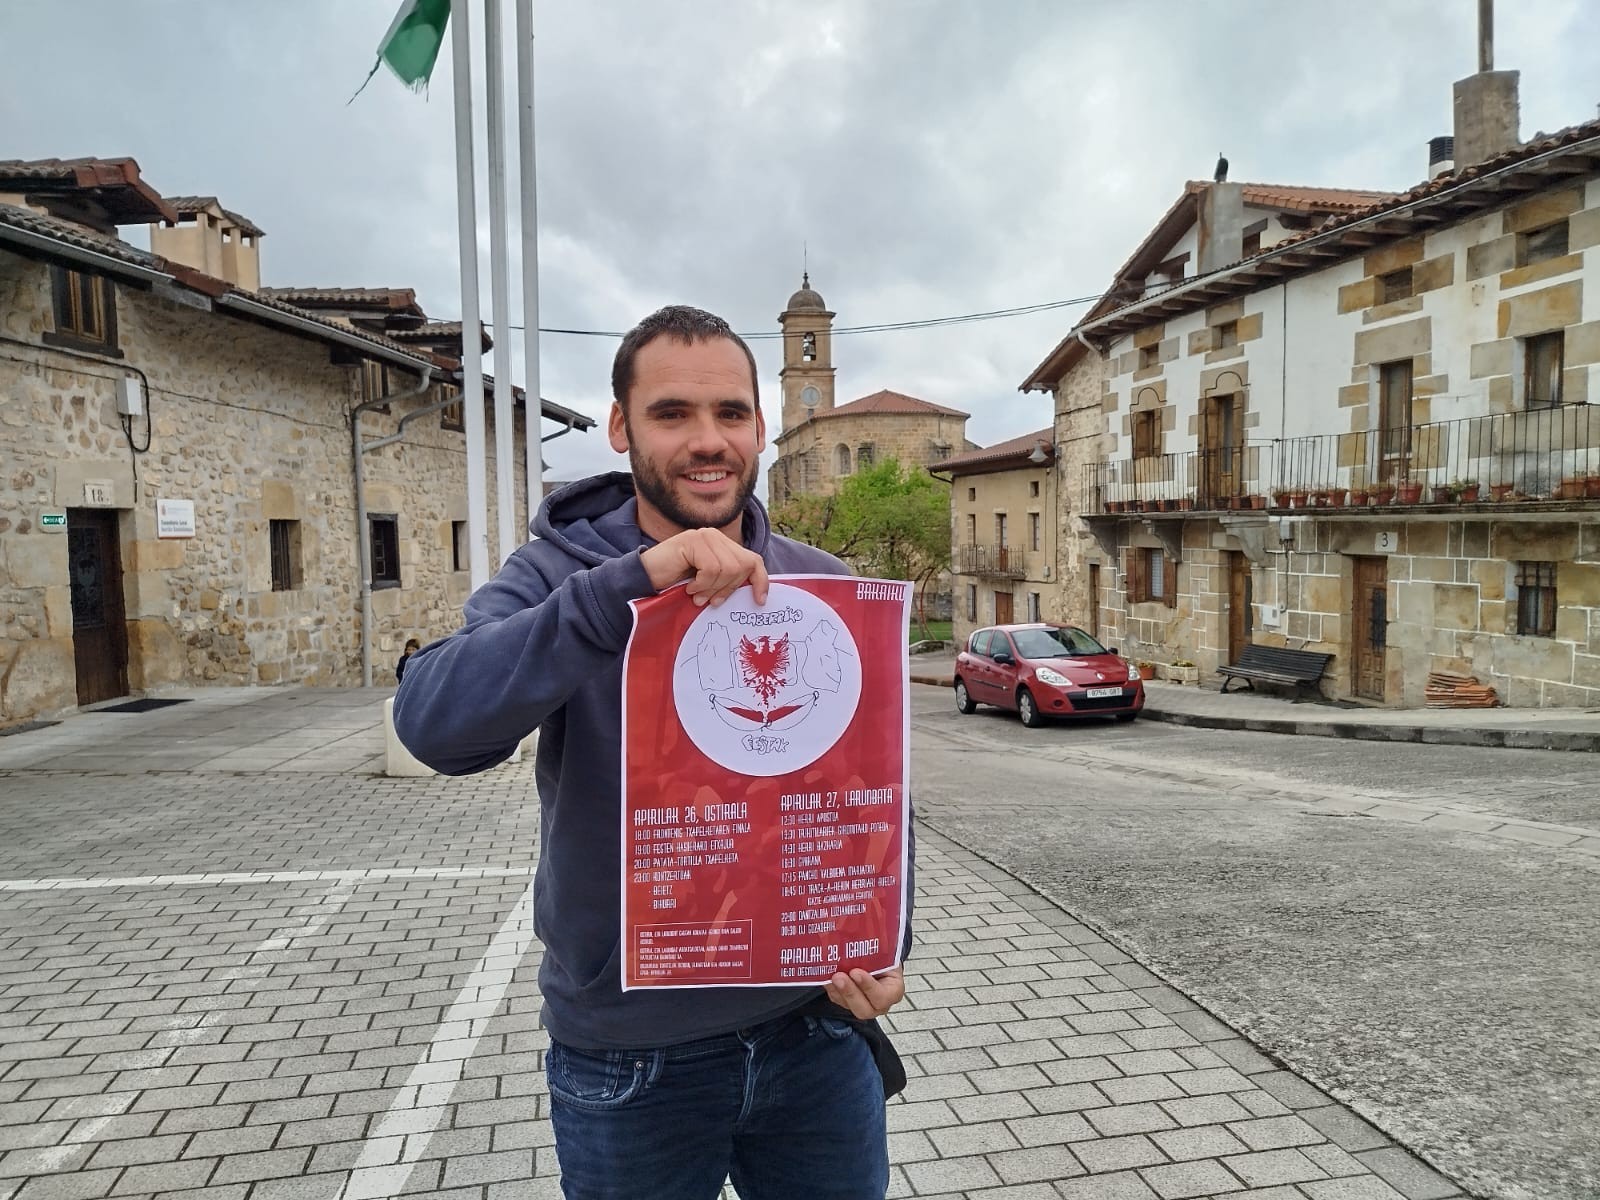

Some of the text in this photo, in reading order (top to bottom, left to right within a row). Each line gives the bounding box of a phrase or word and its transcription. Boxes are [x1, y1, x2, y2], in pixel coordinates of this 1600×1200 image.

[1382, 532, 1388, 548] 3
[856, 582, 905, 601] BAKAIKU
[741, 734, 790, 755] FESTAK
[780, 788, 892, 812] APIRILAK 27, LARUNBATA
[634, 802, 747, 826] APIRILAK 26, OSTIRALA
[653, 842, 674, 854] FESTEN
[780, 946, 823, 964] APIRILAK
[846, 938, 879, 958] IGANDEA
